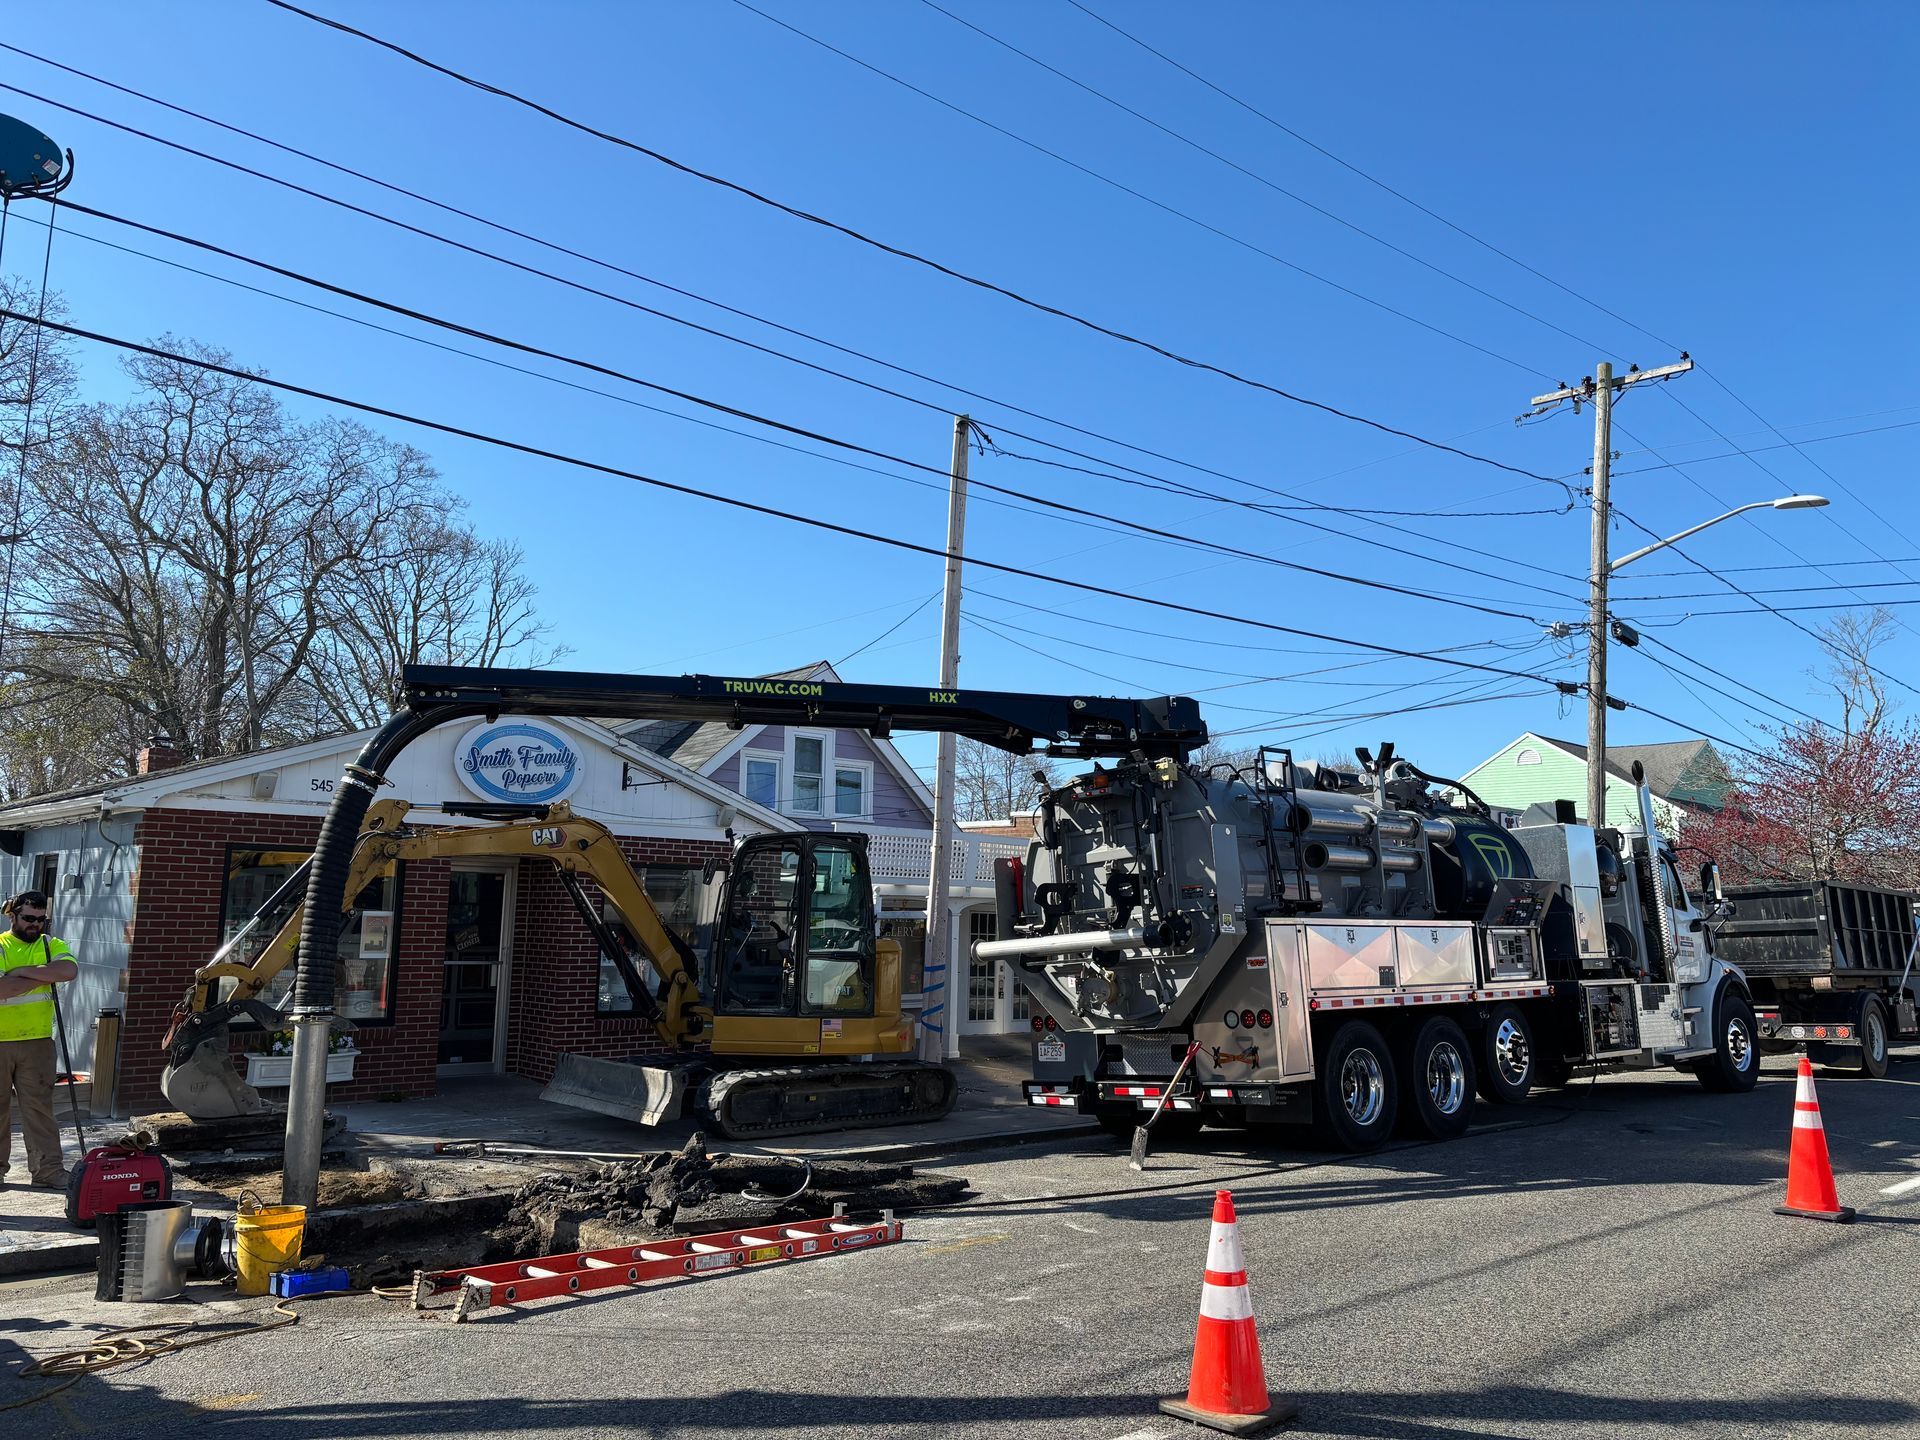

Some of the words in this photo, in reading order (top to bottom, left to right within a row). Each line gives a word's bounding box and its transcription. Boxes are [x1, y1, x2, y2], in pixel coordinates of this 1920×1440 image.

[723, 681, 822, 696] TRUVAC.COM
[464, 746, 514, 772] Smith
[517, 745, 576, 771] Family
[311, 778, 334, 793] 545
[501, 768, 558, 789] Popcorn
[532, 827, 558, 846] CAT
[835, 985, 851, 996] CAT
[103, 1172, 140, 1180] HONDA
